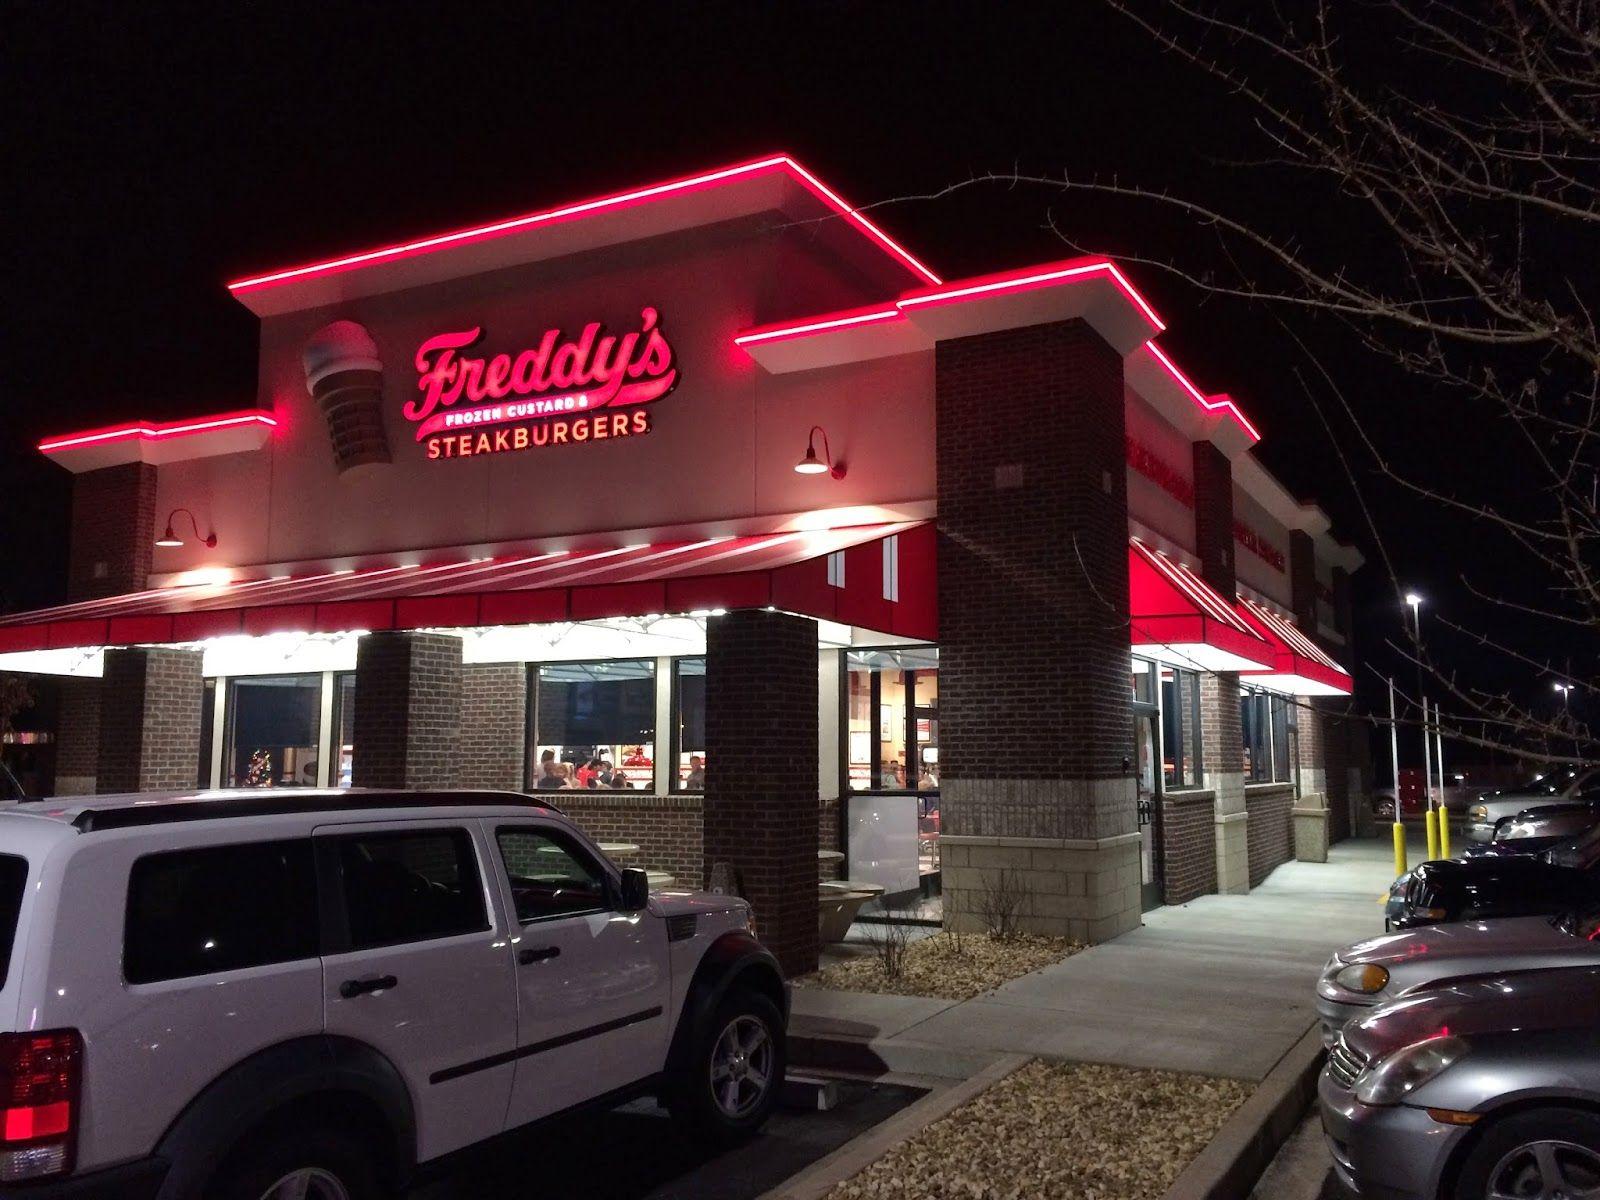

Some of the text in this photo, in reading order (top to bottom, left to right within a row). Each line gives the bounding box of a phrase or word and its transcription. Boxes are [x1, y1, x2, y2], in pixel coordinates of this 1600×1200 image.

[403, 306, 673, 421] Freddy's
[427, 411, 650, 459] STEAKBURGERS
[445, 407, 502, 427] FROZEN
[507, 397, 575, 417] CUSTARD
